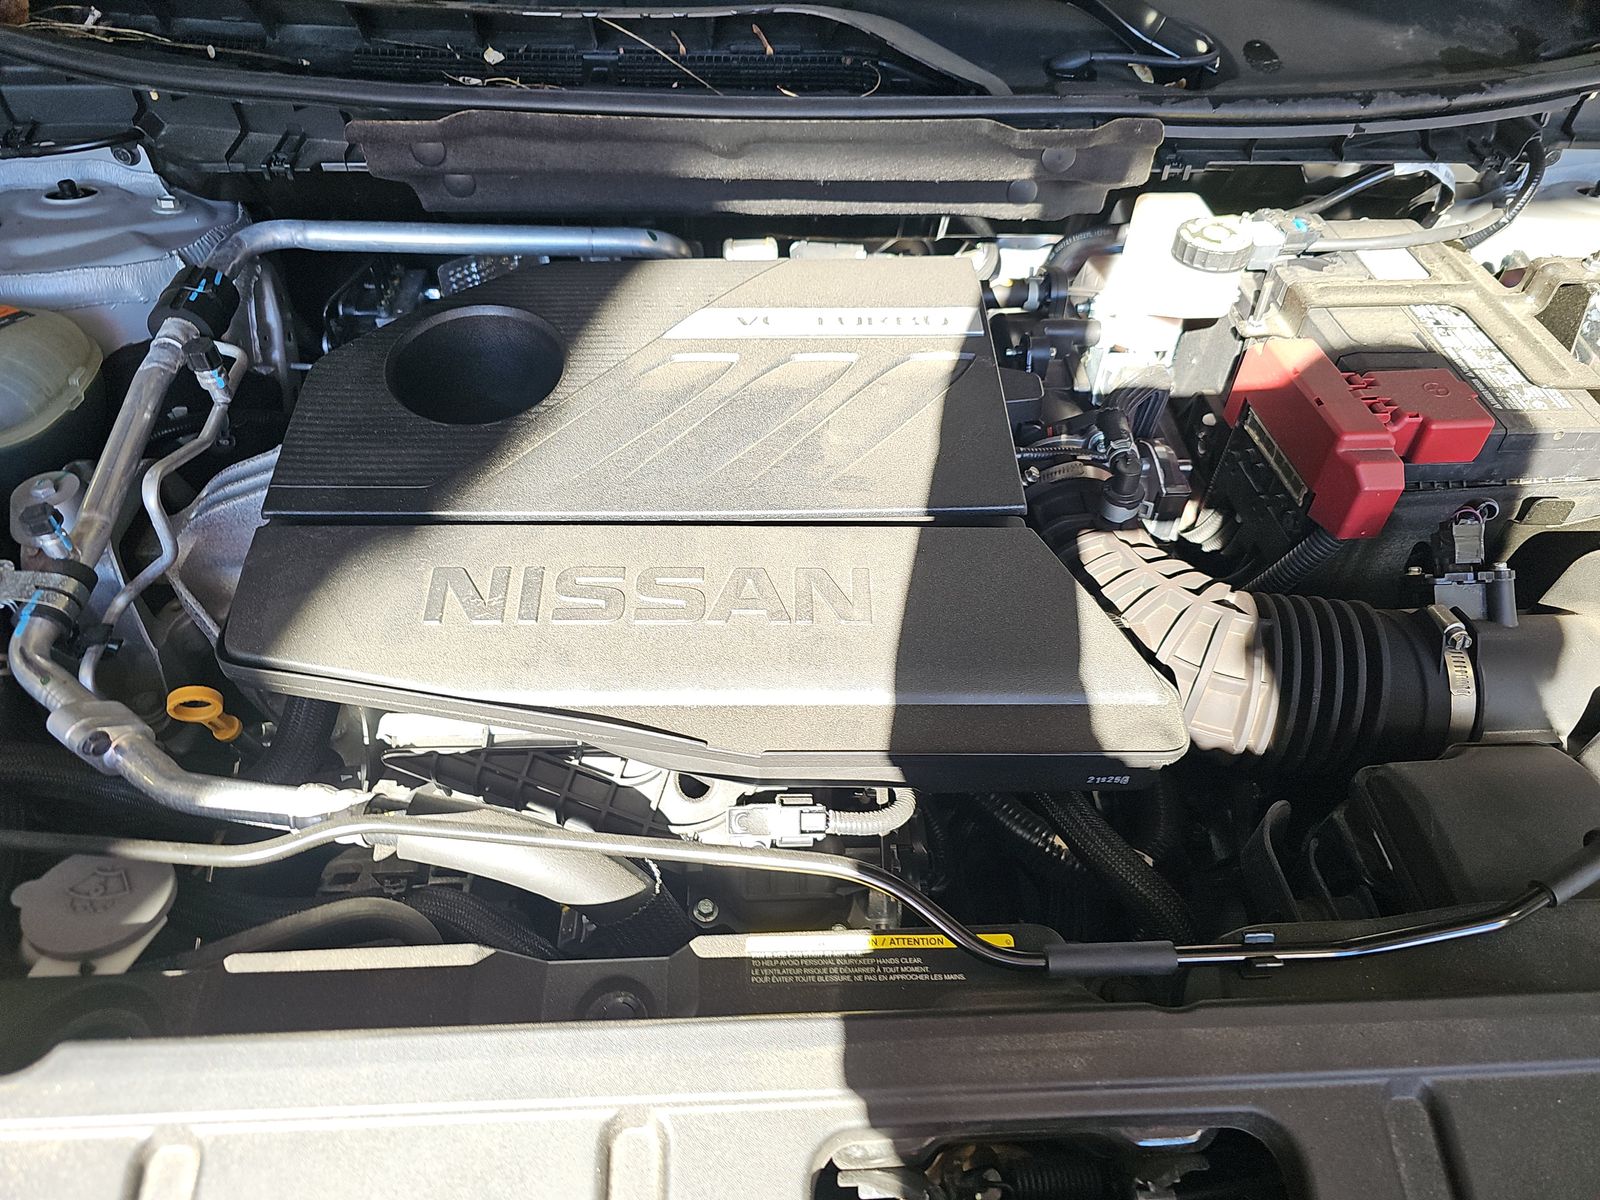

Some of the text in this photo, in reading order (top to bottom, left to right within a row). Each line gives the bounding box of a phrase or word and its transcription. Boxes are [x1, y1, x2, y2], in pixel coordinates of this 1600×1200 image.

[423, 566, 873, 626] NISSAN
[889, 937, 944, 946] ATTENTION
[751, 959, 761, 967] TO
[762, 959, 779, 967] HELP
[779, 958, 800, 966] AVOID
[800, 958, 835, 966] PERSONAL
[876, 956, 900, 964] HANDS
[751, 967, 760, 975] LE
[761, 967, 803, 975] VENTILATEUR
[803, 967, 829, 975] RISQUE
[829, 966, 838, 974] DE
[882, 965, 900, 973] TOUT
[751, 975, 772, 983] POUR
[795, 974, 817, 982] TOUTE
[853, 973, 865, 982] NE
[866, 973, 879, 982] PAS
[880, 973, 890, 981] EN
[890, 973, 931, 981] APPROCHER
[931, 972, 944, 981] LES
